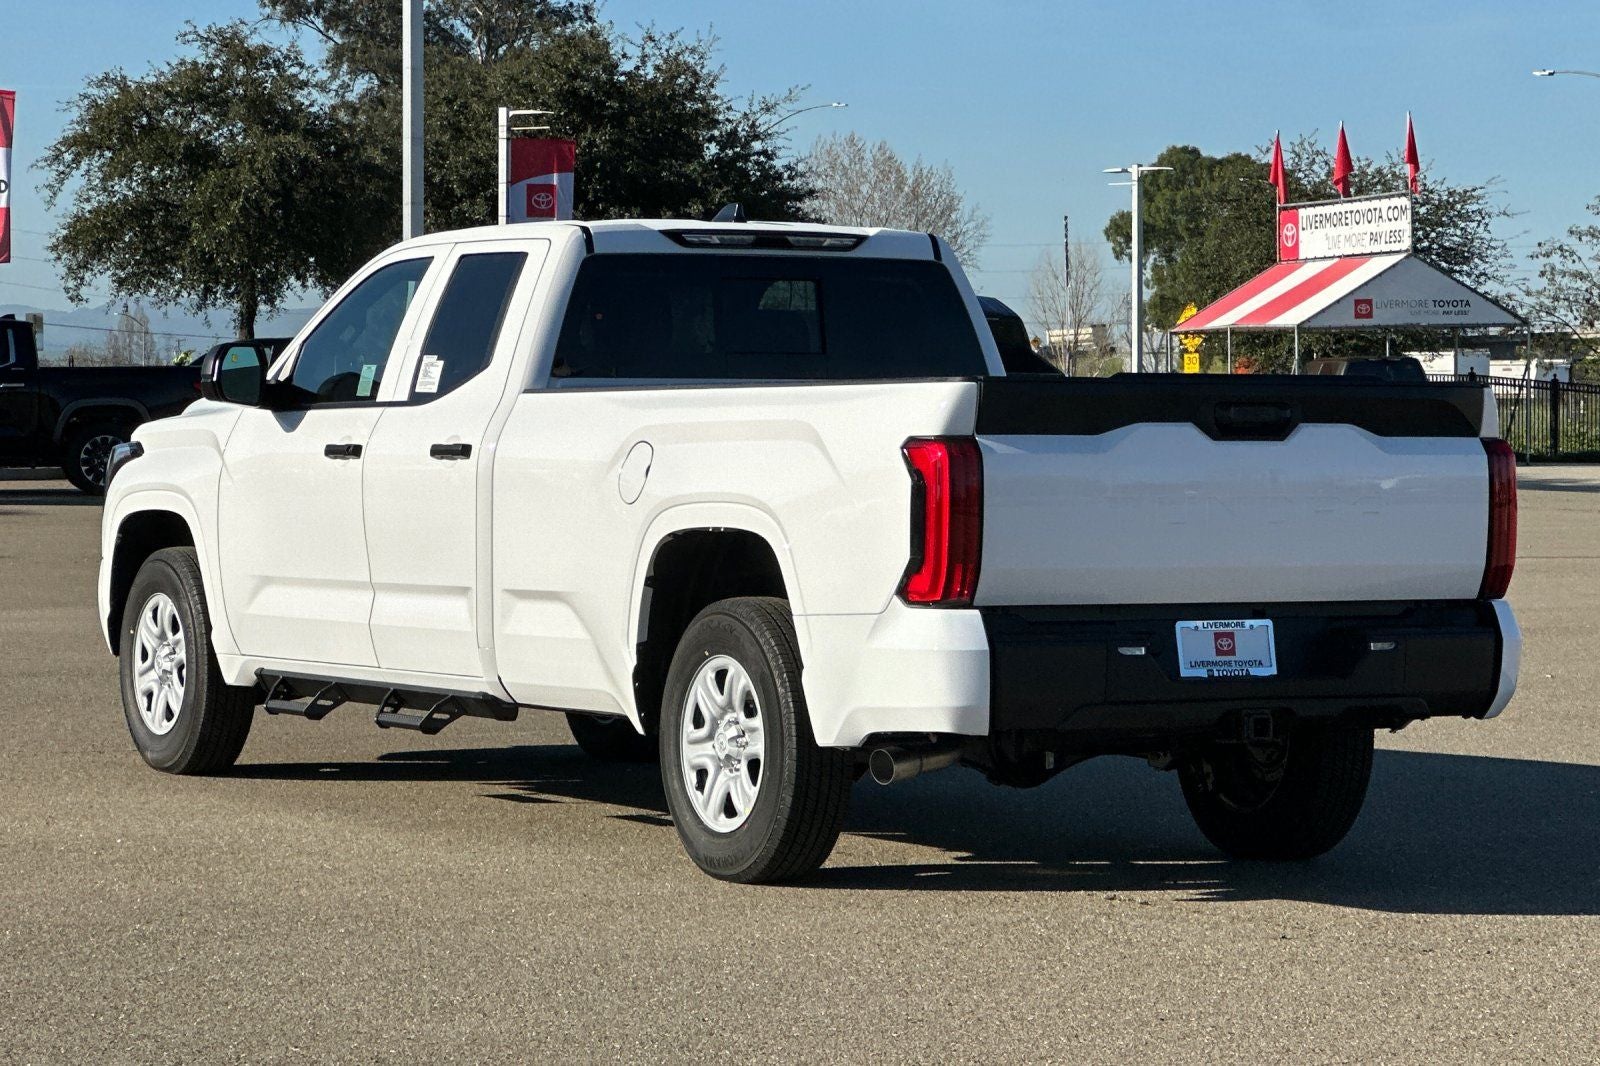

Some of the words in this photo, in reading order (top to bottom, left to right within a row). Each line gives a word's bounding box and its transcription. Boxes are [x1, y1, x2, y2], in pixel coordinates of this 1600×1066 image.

[1301, 204, 1408, 231] LIVERMORETOYOTA.COM
[1369, 231, 1384, 246] PAY
[1375, 299, 1429, 310] LIVERMORE
[1431, 299, 1471, 308] TOYOTA
[1186, 356, 1198, 366] 30
[1202, 621, 1246, 629] LIVERMORE
[1189, 660, 1233, 668] LIVERMORE
[1234, 660, 1263, 668] TOYOTA
[1216, 668, 1250, 677] TOYOTA
